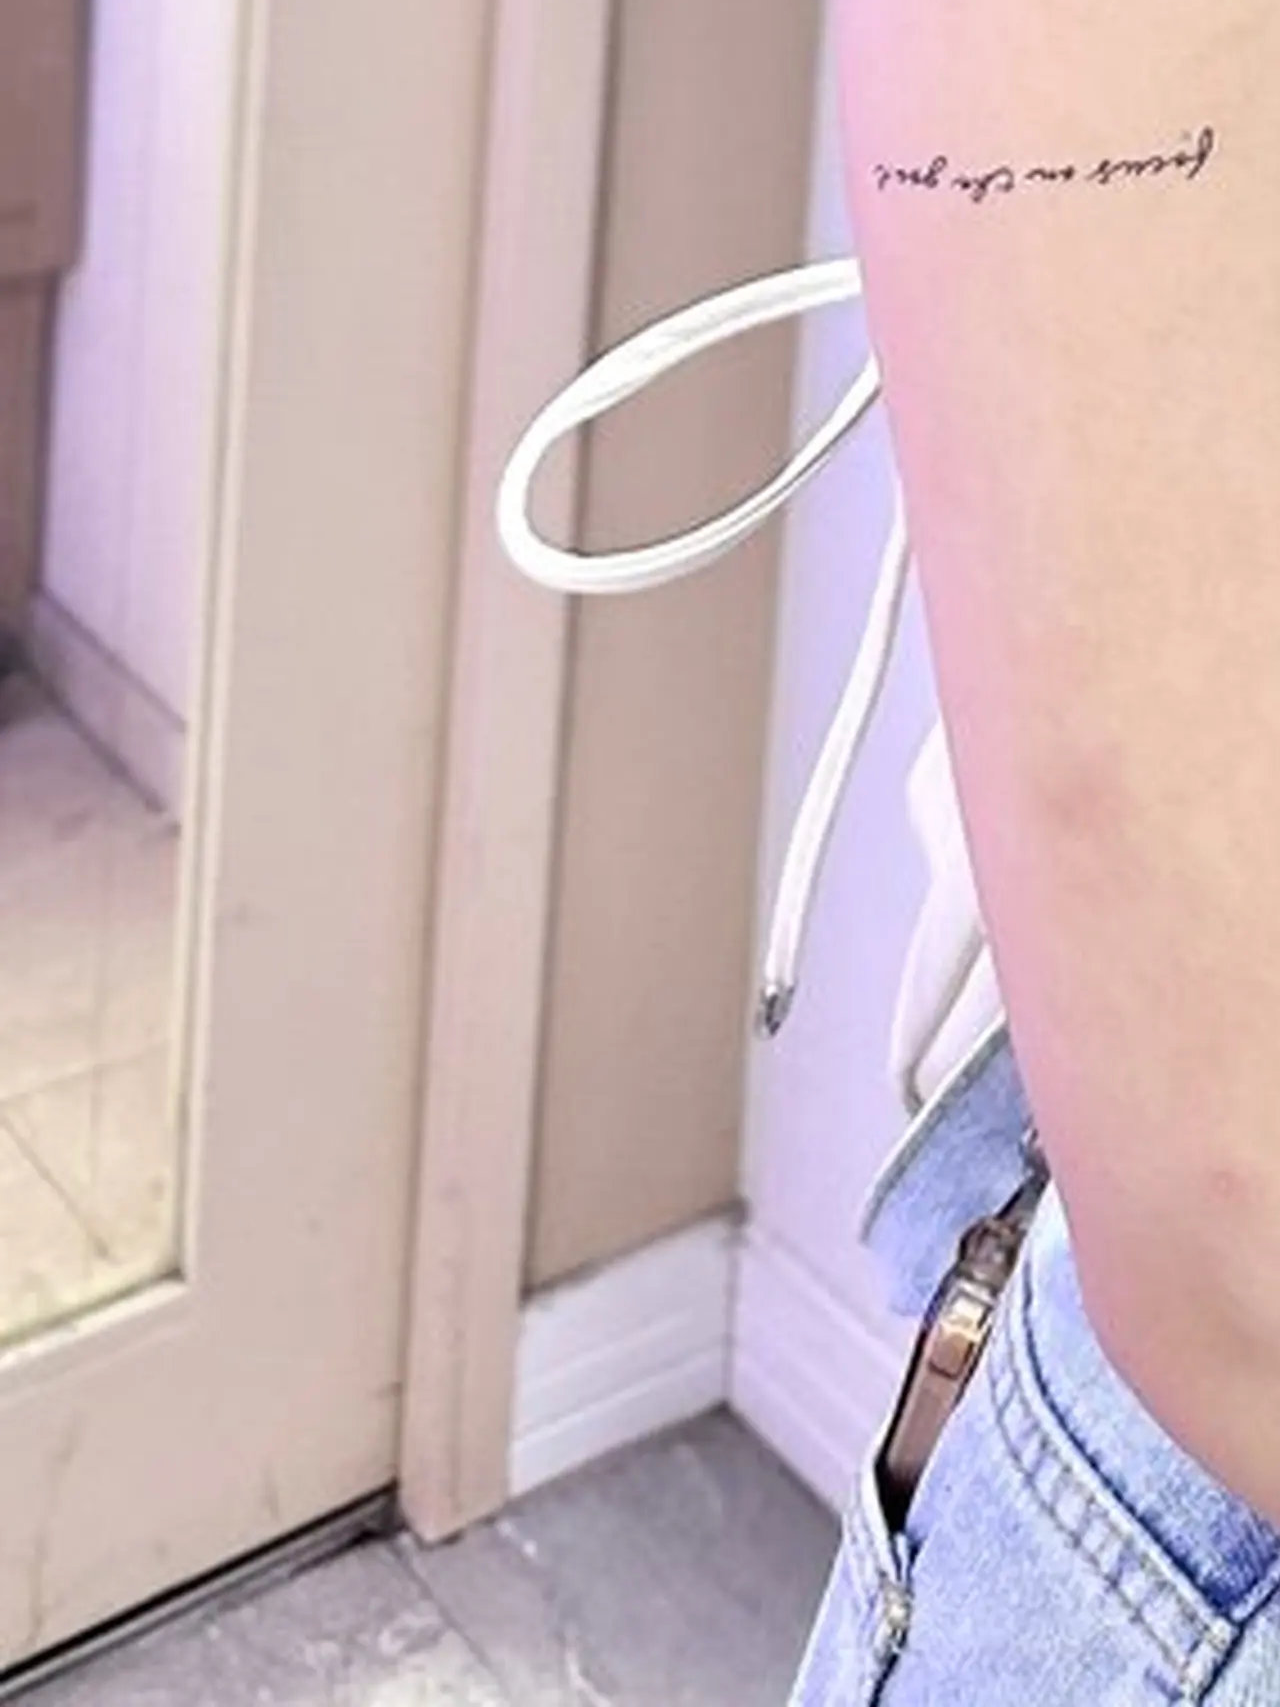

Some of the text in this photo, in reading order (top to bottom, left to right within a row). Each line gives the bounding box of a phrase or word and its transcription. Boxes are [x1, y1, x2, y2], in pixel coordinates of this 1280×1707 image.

[1025, 165, 1076, 182] on
[1086, 126, 1214, 185] focus
[950, 167, 1015, 204] the
